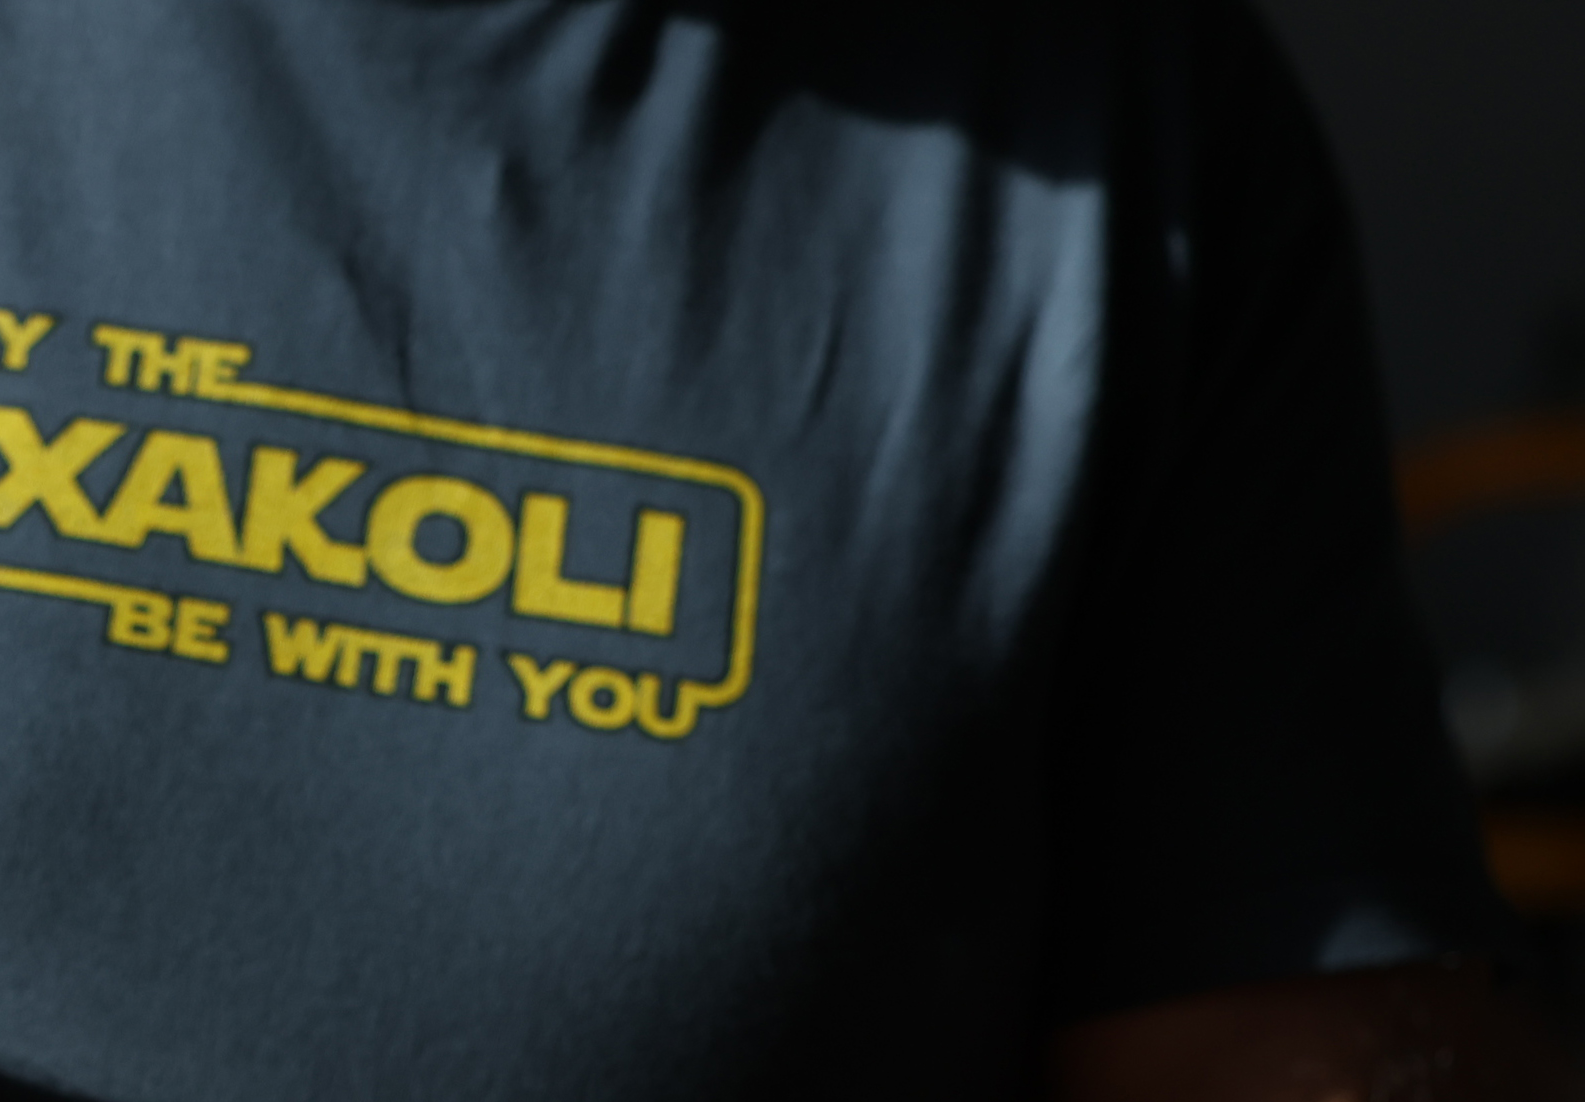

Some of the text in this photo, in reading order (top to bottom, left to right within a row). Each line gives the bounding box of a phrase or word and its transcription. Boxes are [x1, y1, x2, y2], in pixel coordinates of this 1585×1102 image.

[93, 323, 251, 399] THE
[106, 594, 700, 740] BE WITH YOU
